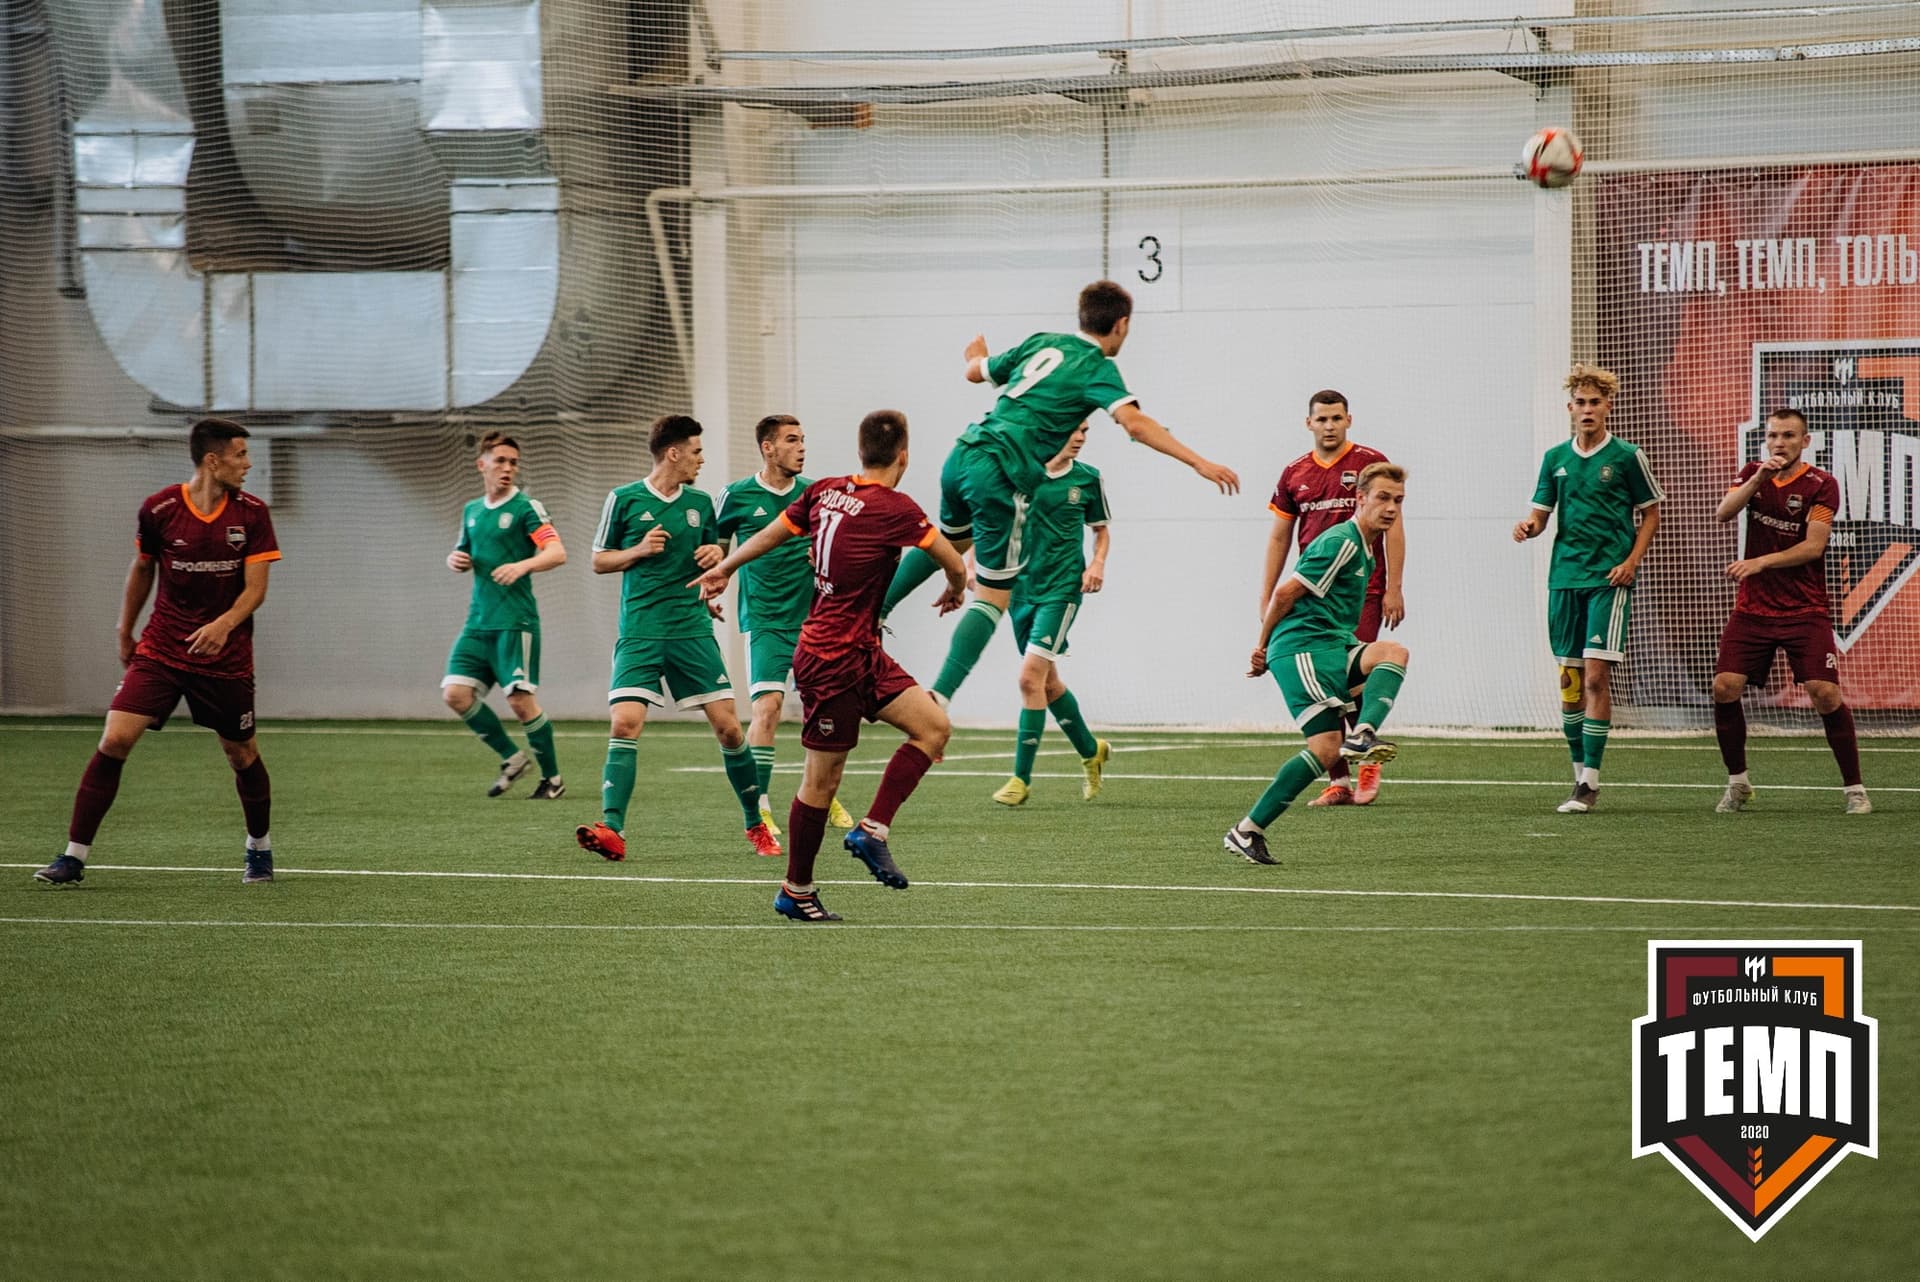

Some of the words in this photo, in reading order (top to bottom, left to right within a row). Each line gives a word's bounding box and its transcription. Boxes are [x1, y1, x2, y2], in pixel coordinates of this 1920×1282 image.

[1138, 235, 1163, 284] 3
[1638, 241, 1726, 297] ТЕМП,
[1735, 237, 1825, 293] ТЕМП,
[1836, 234, 1918, 287] ТОЛЬ
[1007, 347, 1065, 400] 9
[1789, 387, 1863, 409] ФУТБОЛЬНЫЙ
[1868, 390, 1900, 409] КЛУБ
[816, 507, 844, 578] 11
[1830, 531, 1856, 547] 2020
